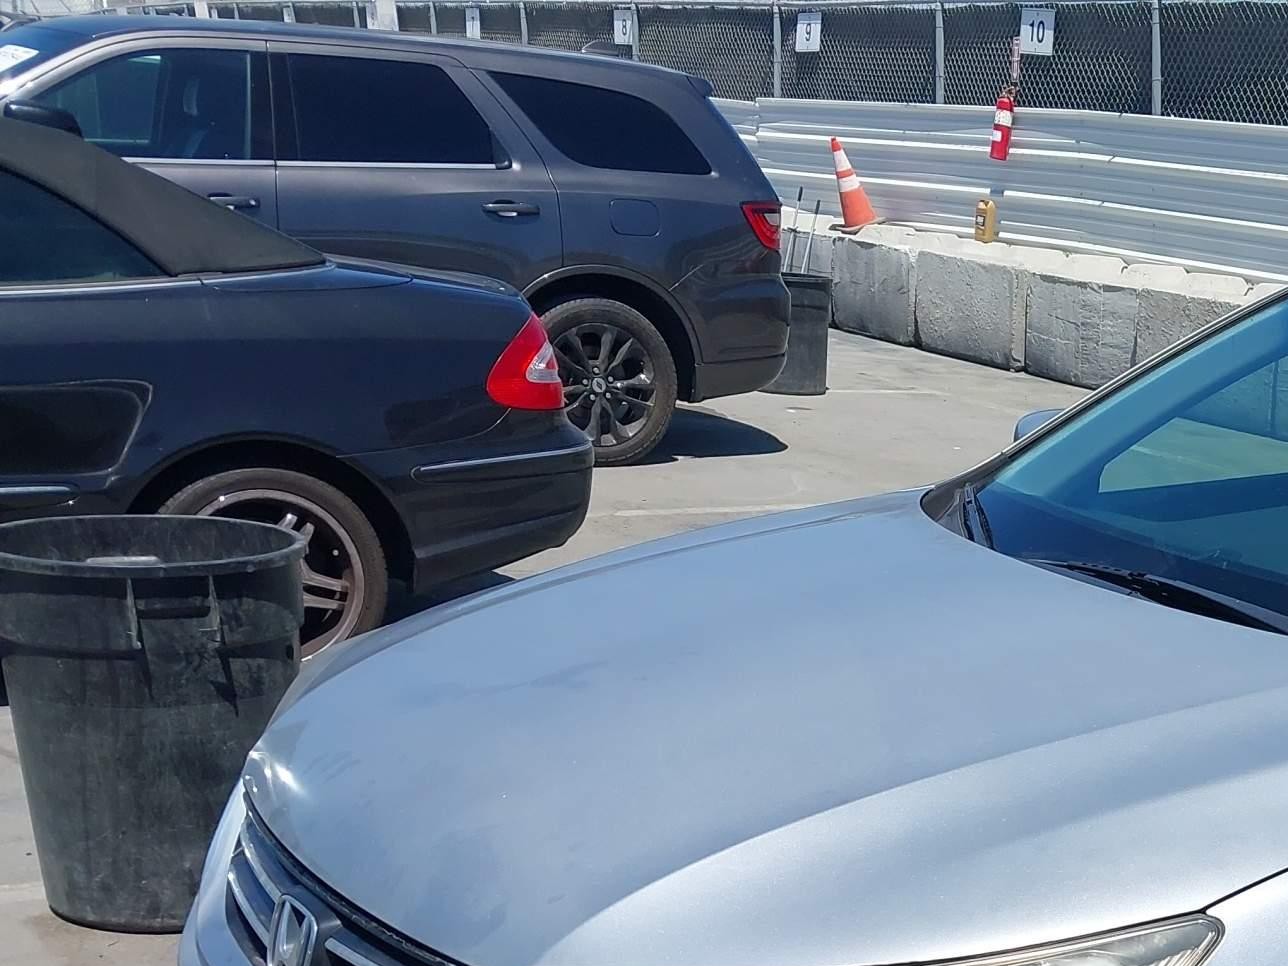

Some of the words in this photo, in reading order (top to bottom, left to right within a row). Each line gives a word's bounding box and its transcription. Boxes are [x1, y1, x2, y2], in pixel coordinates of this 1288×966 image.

[621, 18, 628, 36] 8
[805, 22, 812, 42] 9
[1028, 19, 1045, 44] 10
